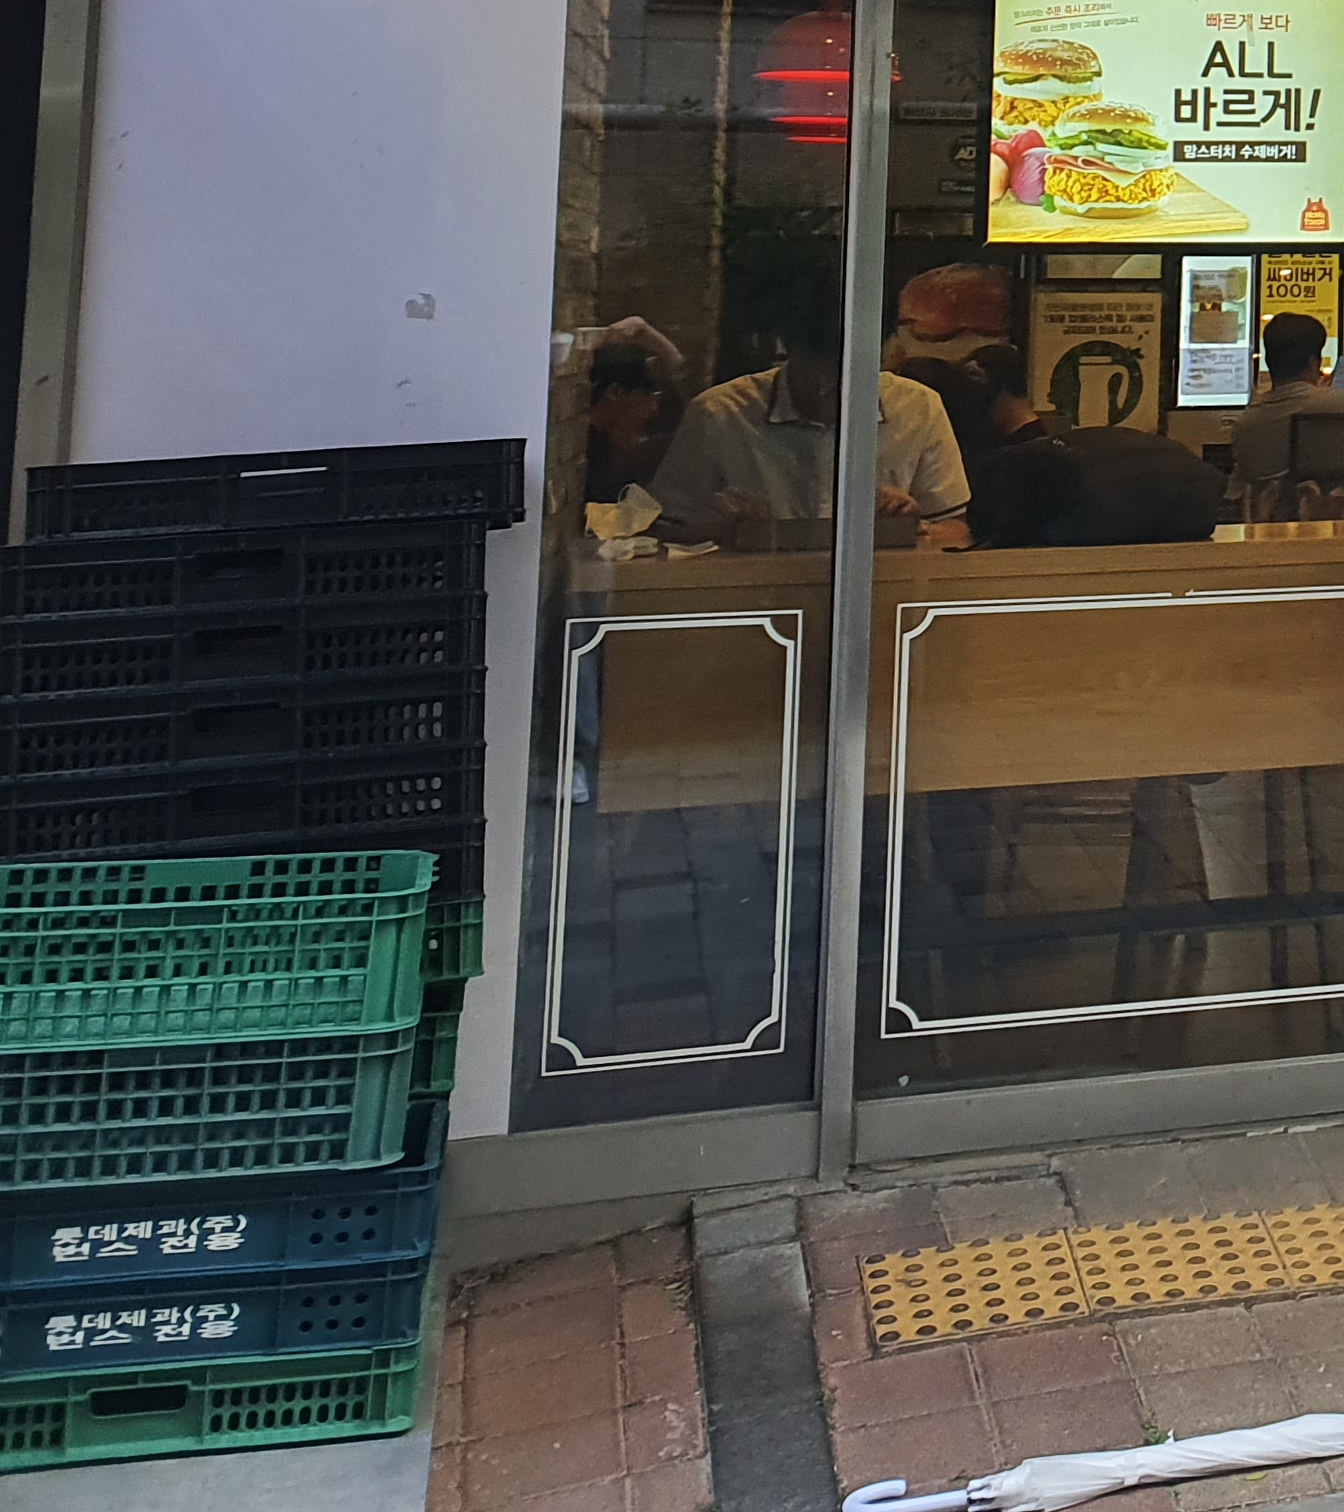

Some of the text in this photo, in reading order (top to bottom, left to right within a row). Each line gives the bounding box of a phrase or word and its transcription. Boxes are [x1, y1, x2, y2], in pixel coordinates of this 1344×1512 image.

[1206, 13, 1291, 33] 빠르게 보다
[1201, 40, 1293, 79] ALL
[1174, 88, 1322, 132] 바르게!
[1183, 144, 1297, 159] 맘스터치 수제버거!
[51, 1214, 247, 1245] 롯데제과(주)
[159, 1232, 246, 1254] 전용
[44, 1303, 241, 1333] 롯데제과(주)
[153, 1320, 239, 1342] 전용
